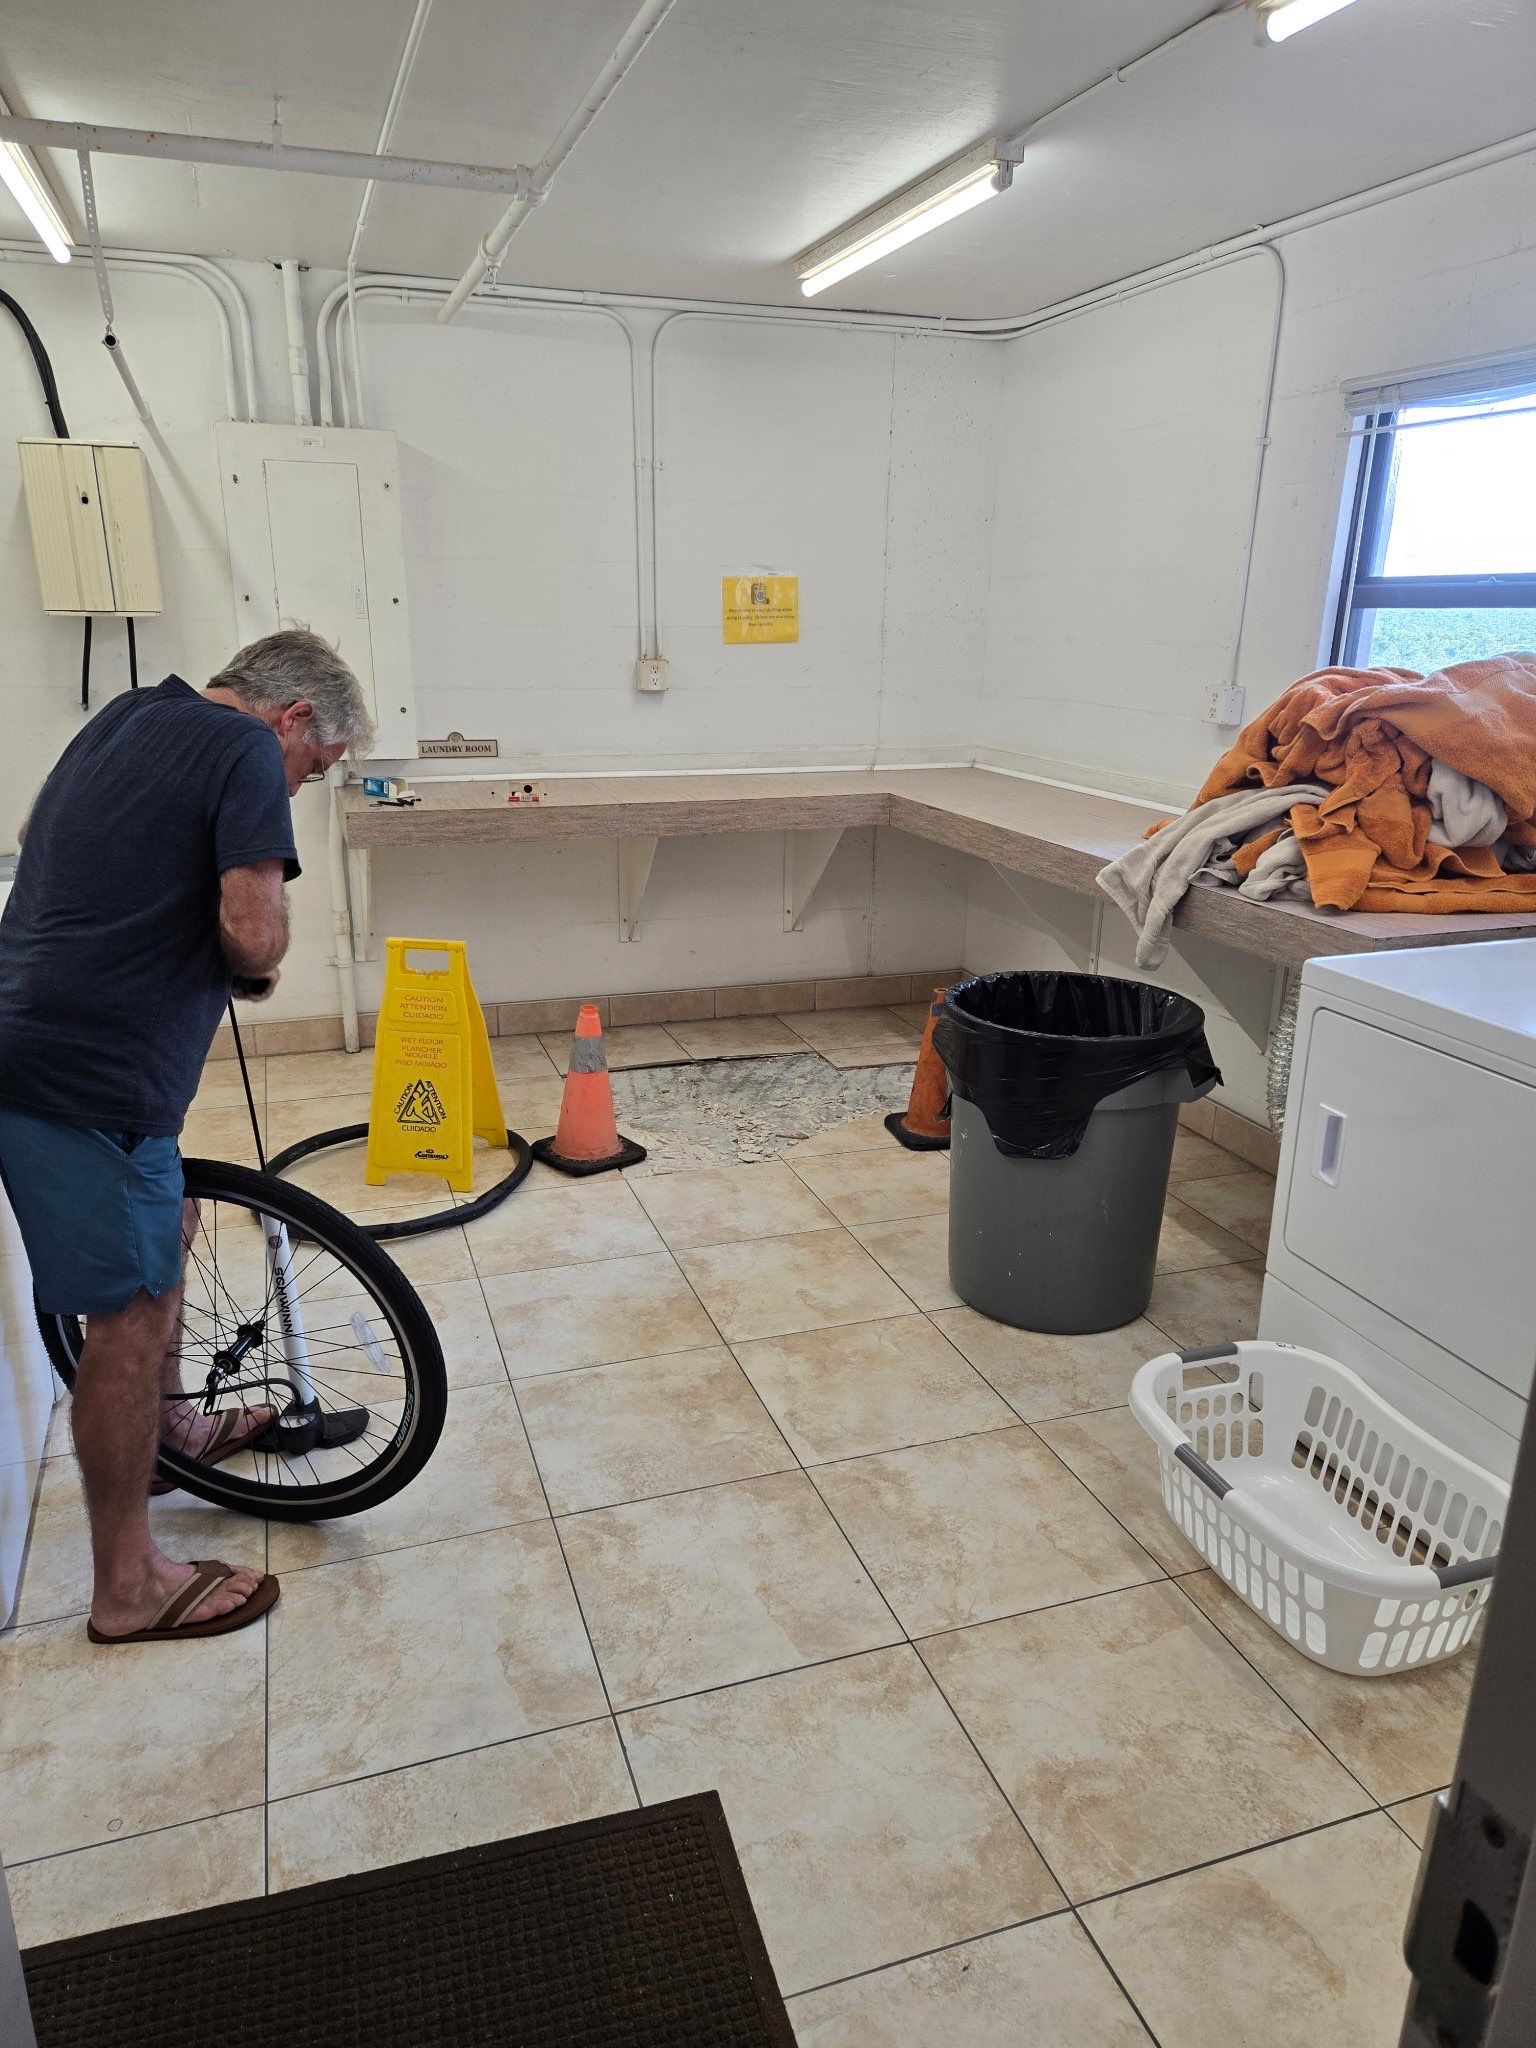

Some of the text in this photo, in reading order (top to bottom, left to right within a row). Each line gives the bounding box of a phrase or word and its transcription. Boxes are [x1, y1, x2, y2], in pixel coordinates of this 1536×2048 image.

[421, 745, 491, 753] LAUNDRY ROOM
[404, 995, 443, 1003] CAUTION
[400, 1003, 448, 1012] ATTENTION
[403, 1011, 444, 1020] CUIDADO
[400, 1036, 444, 1046] WET FLOOR
[401, 1045, 442, 1054] PLANCHER
[415, 1060, 448, 1069] MOJADO
[394, 1083, 414, 1114] CAUTION
[425, 1080, 448, 1120] ATTENTION
[401, 1124, 437, 1133] CUIDADO
[274, 1267, 293, 1333] SCHWINN
